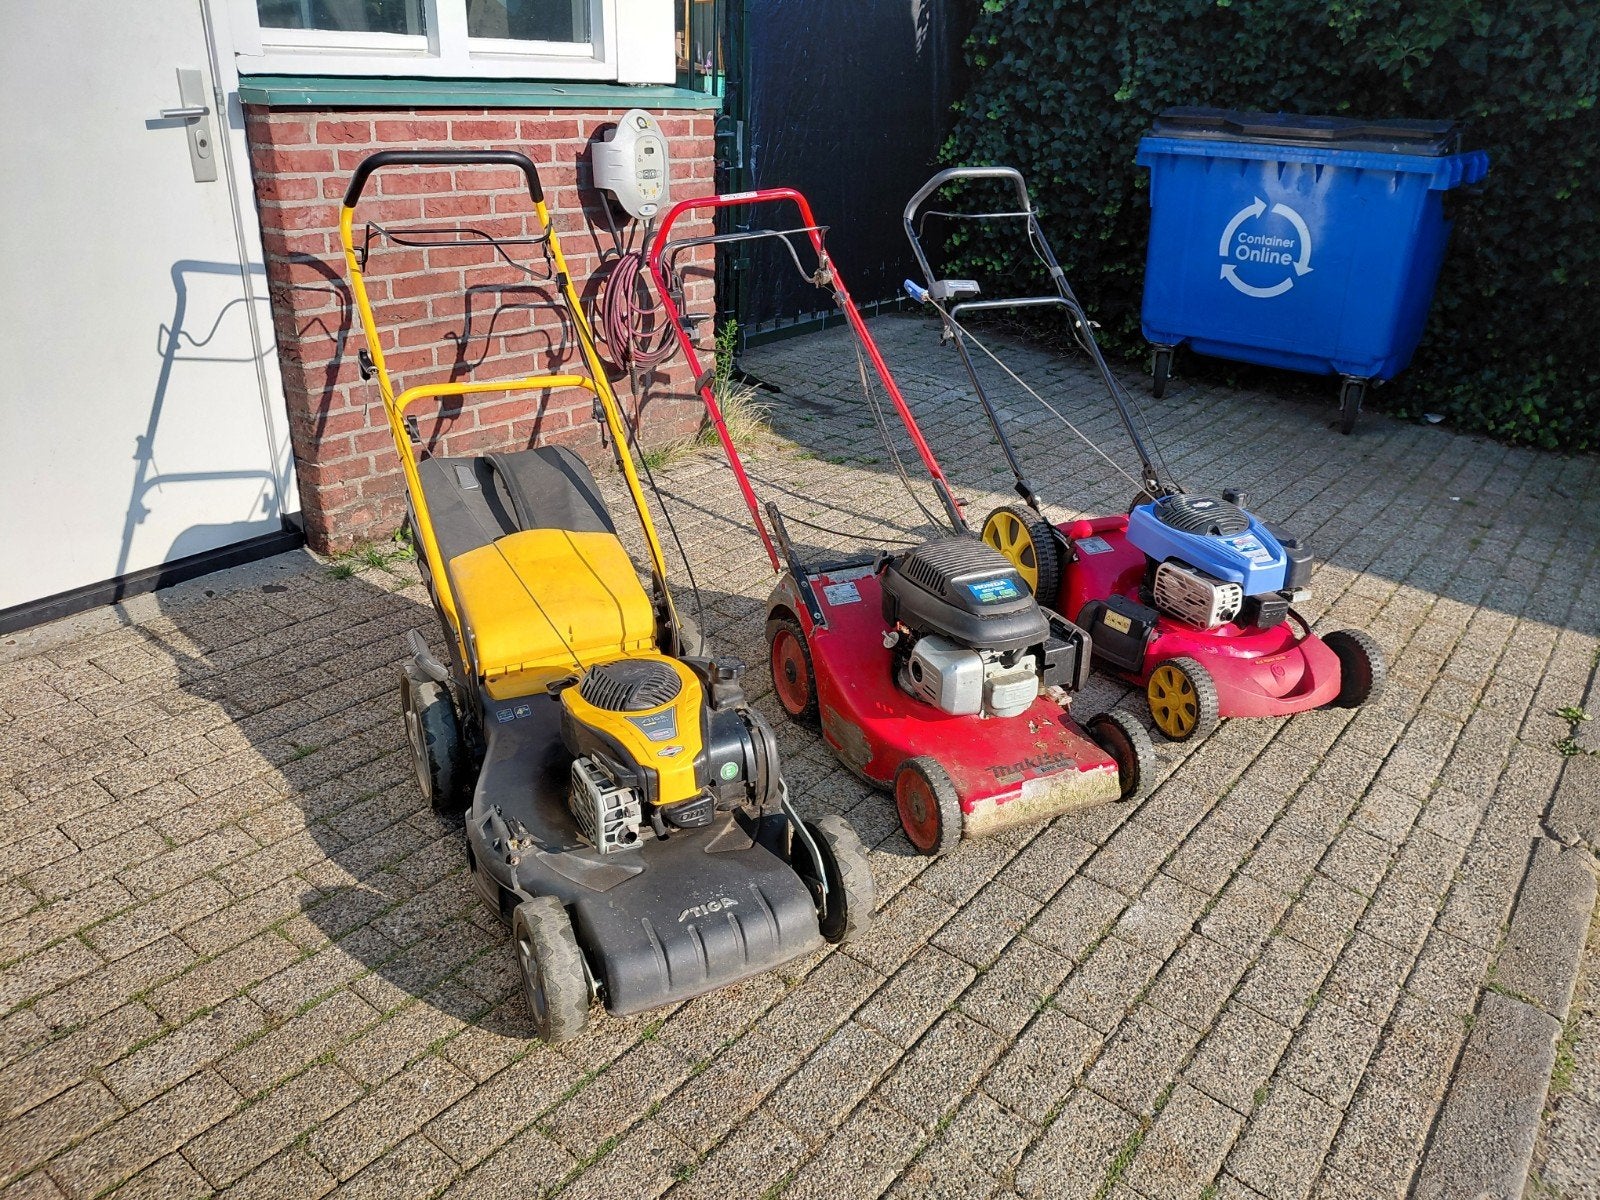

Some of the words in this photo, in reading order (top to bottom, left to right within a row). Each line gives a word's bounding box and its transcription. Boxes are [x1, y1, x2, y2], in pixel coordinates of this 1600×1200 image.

[1238, 232, 1295, 247] Container
[1235, 245, 1292, 265] Online
[973, 581, 1008, 591] HONDA
[680, 806, 709, 821] OHV
[678, 897, 739, 922] STIGA
